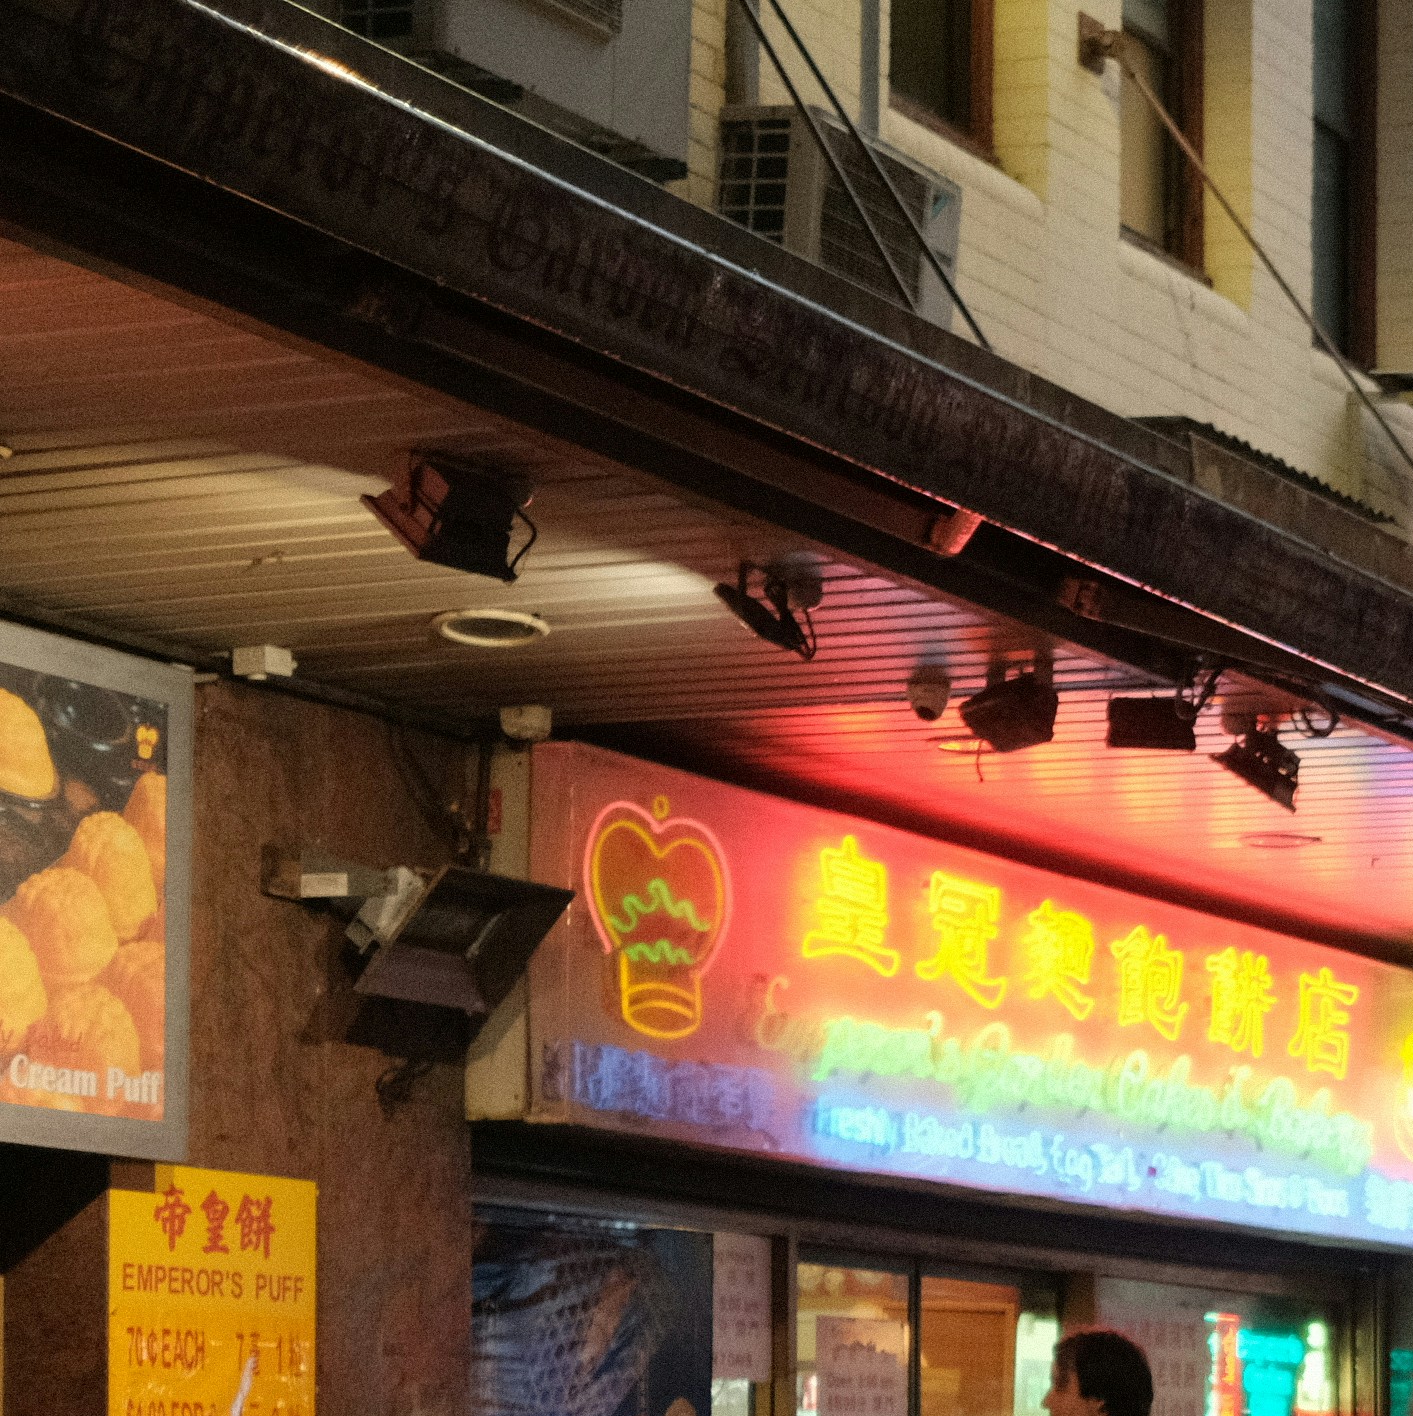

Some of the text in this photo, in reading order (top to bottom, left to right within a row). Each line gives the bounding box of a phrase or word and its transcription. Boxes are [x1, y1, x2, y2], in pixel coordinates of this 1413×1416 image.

[10, 1053, 163, 1105] Cream Puff
[154, 1183, 277, 1260] 帝皇餅
[122, 1262, 305, 1302] EMPEROR'S PUFF
